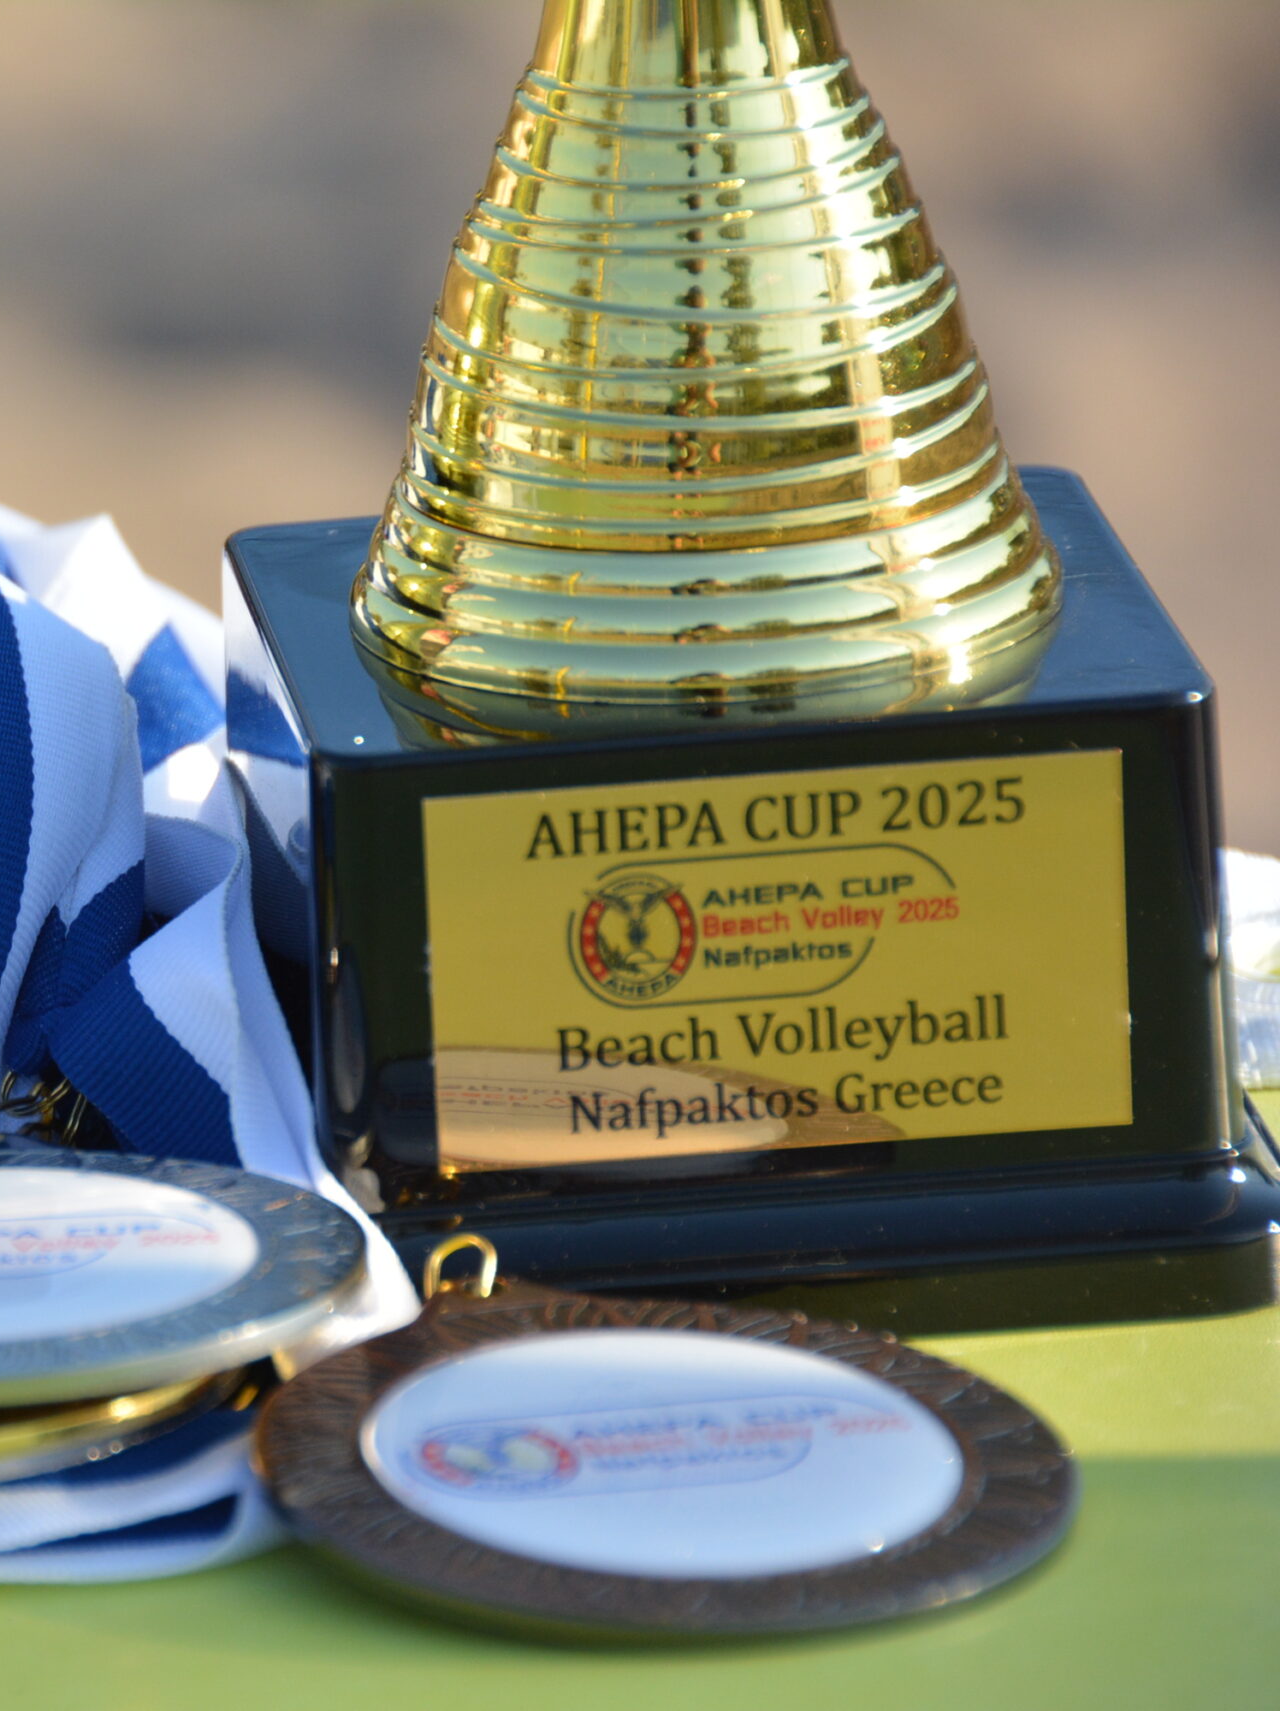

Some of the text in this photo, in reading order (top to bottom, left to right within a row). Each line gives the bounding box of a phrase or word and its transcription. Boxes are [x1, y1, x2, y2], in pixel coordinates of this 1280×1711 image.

[526, 777, 1026, 861] AHEPA CUP 2025
[702, 875, 914, 909] AHEPA CUP
[702, 896, 959, 938] Beach Volley 2025
[703, 941, 852, 970] Nafpaktos
[606, 974, 677, 997] AHEPA
[556, 994, 1010, 1073] Beach Volleyball
[568, 1078, 818, 1139] Nafpaktos
[835, 1071, 1004, 1113] Greece
